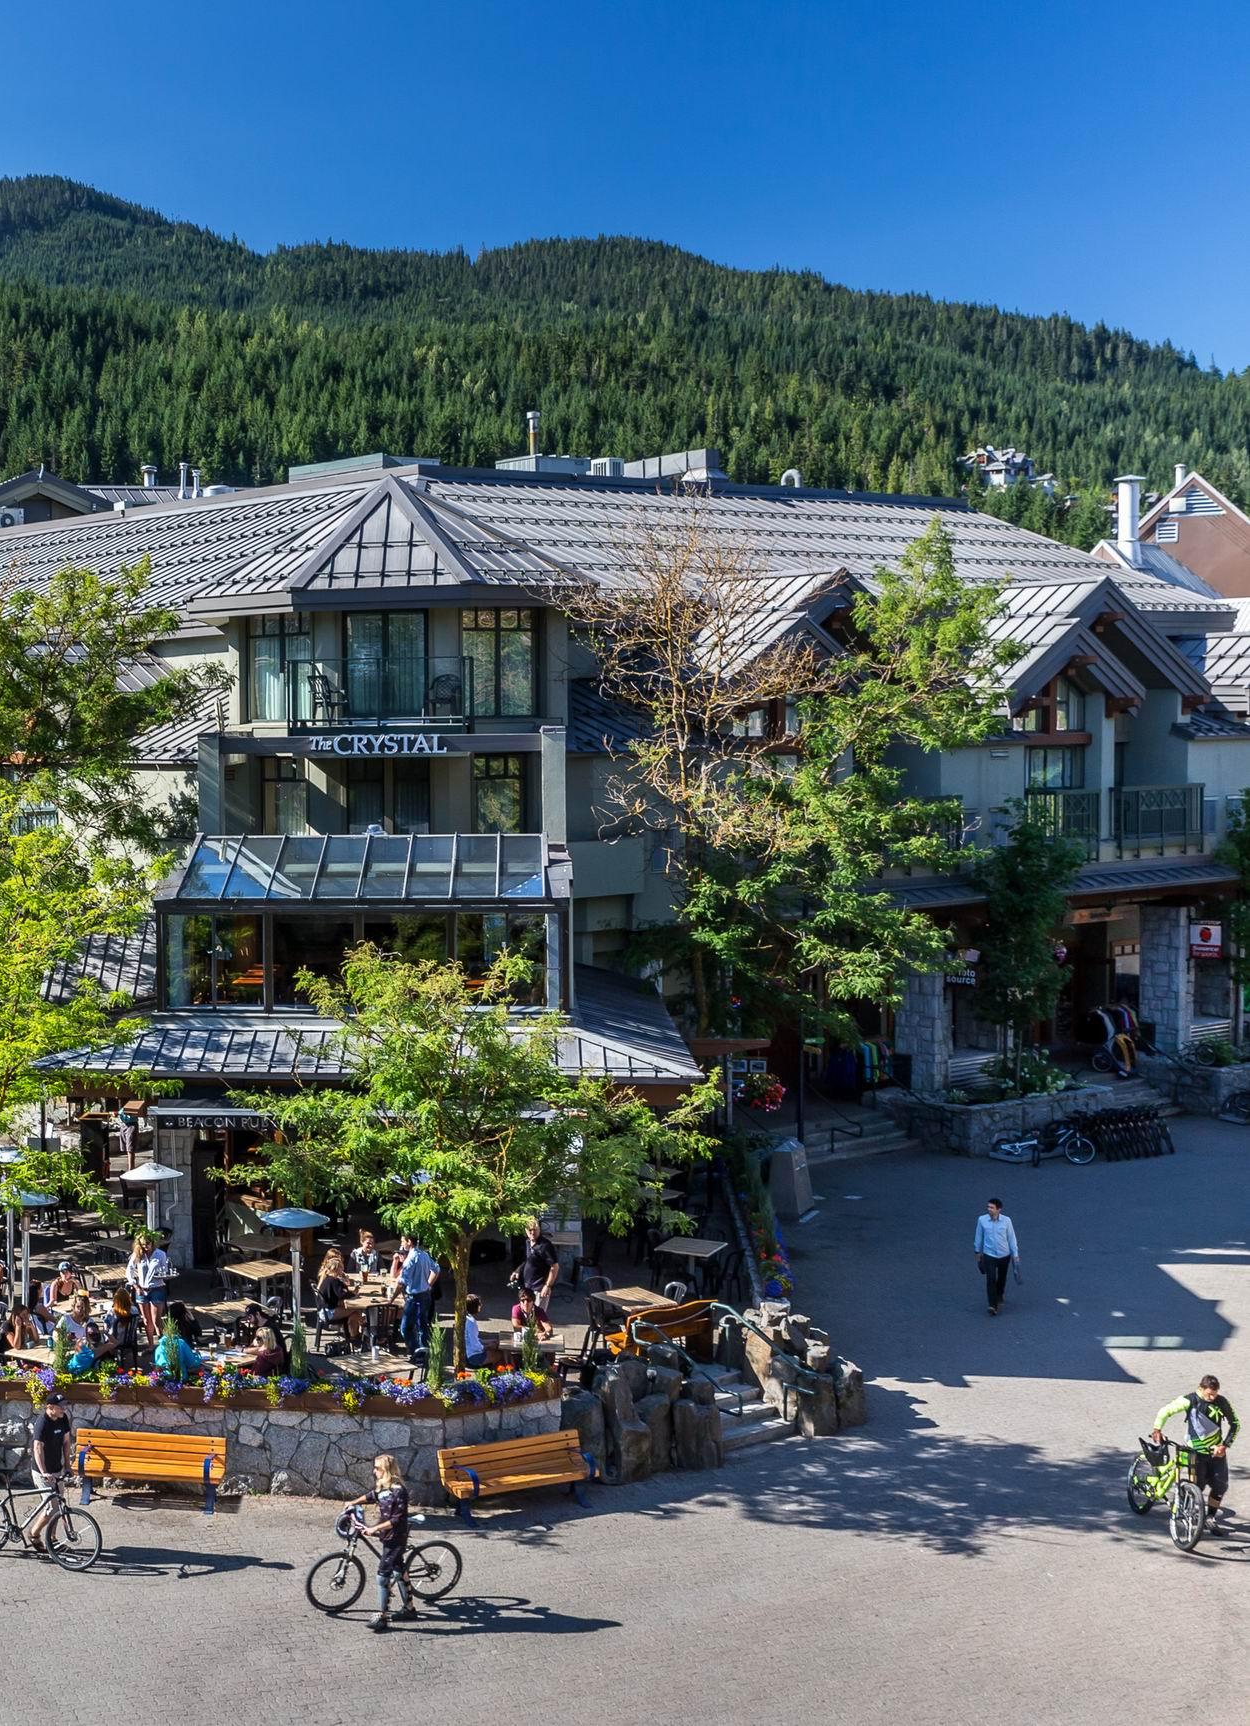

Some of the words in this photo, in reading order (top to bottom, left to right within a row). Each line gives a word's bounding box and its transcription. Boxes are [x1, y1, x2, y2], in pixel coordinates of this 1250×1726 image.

[309, 736, 332, 751] The
[332, 733, 448, 755] CRYSTAL
[946, 976, 976, 985] source
[177, 1116, 236, 1128] BEACON
[241, 1117, 269, 1128] PUB
